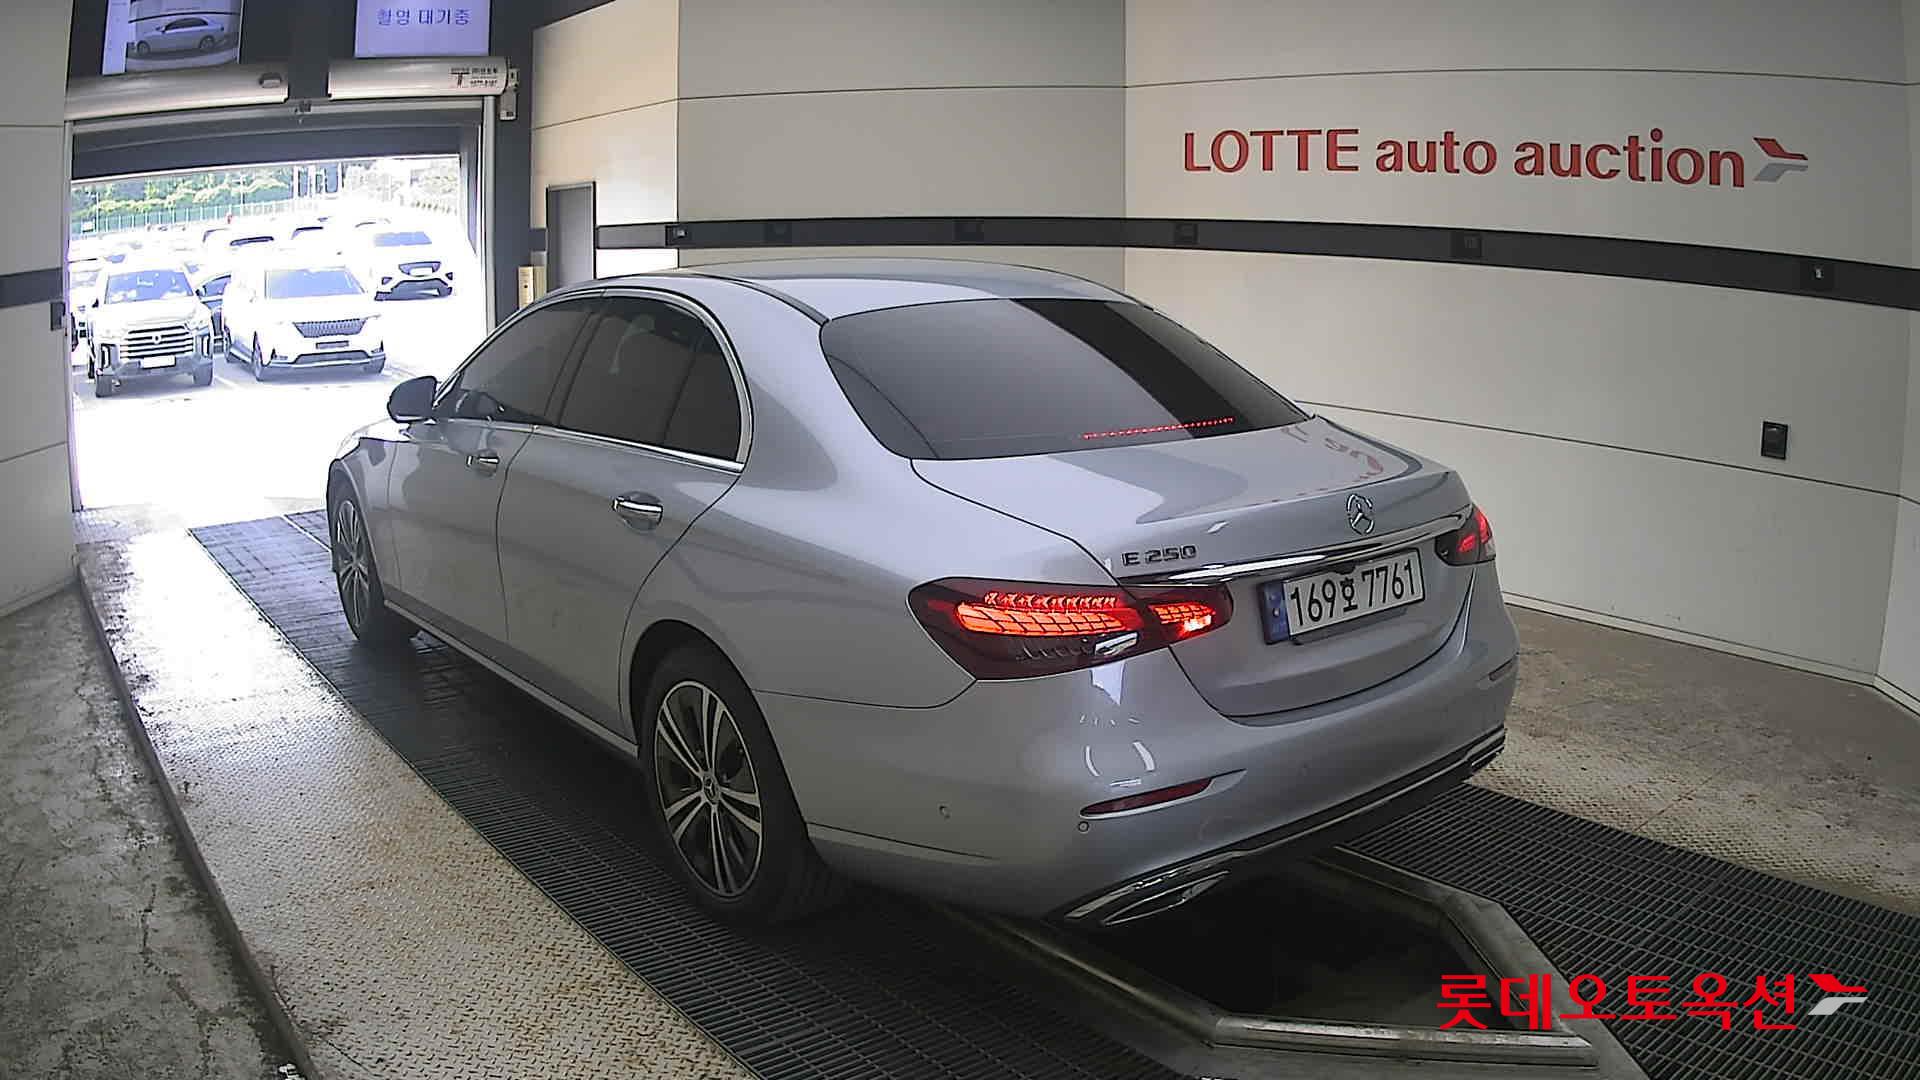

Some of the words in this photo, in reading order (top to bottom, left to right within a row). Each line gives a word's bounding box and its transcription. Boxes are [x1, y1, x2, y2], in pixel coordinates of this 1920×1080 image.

[418, 8, 471, 25] 대기중
[1184, 129, 1359, 172] LOTTE
[1375, 130, 1497, 175] auto
[1513, 128, 1744, 187] auction
[1121, 552, 1140, 566] E
[1144, 545, 1197, 564] 250
[1361, 559, 1415, 607] 7761
